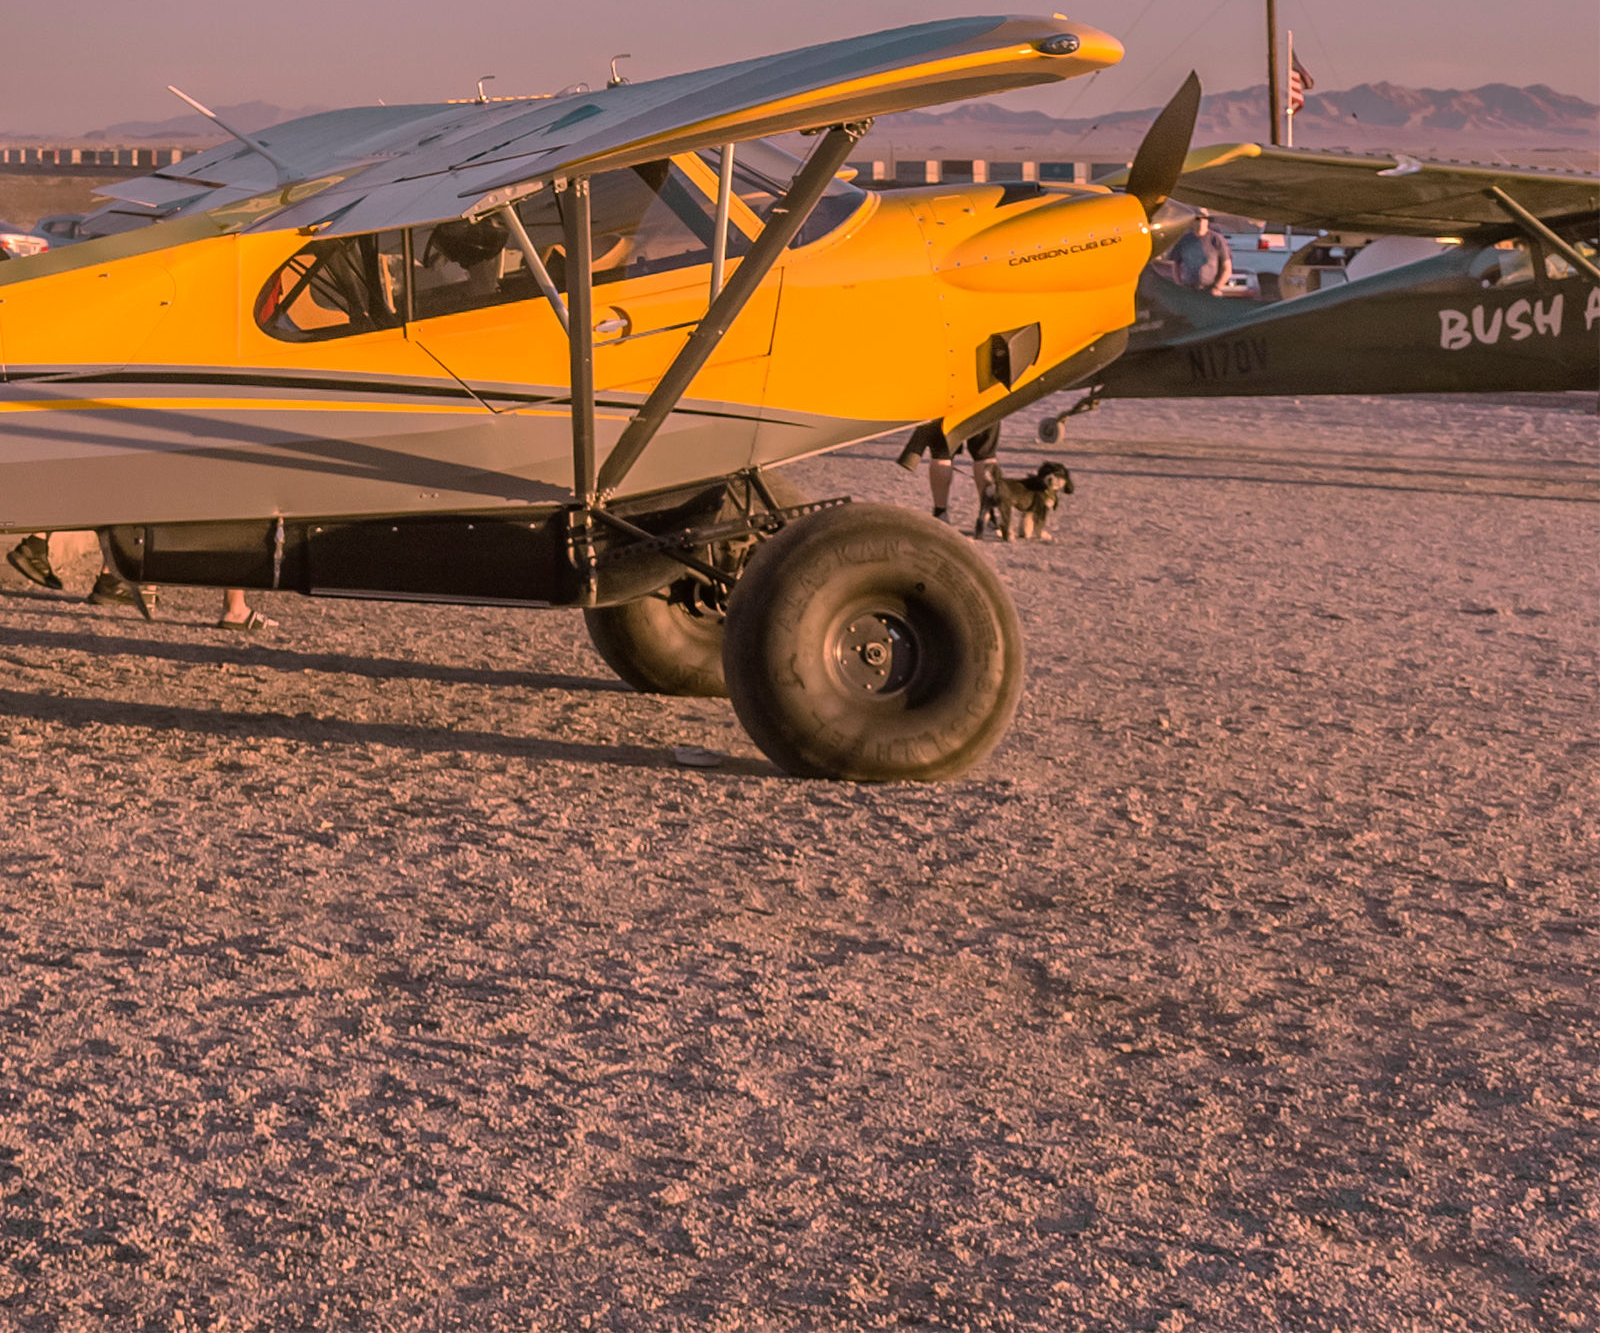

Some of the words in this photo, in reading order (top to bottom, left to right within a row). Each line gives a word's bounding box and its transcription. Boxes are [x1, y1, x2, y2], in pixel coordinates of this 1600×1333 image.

[1009, 248, 1069, 266] CARBON
[1070, 241, 1098, 254] CUB
[1438, 293, 1566, 351] BUSH
